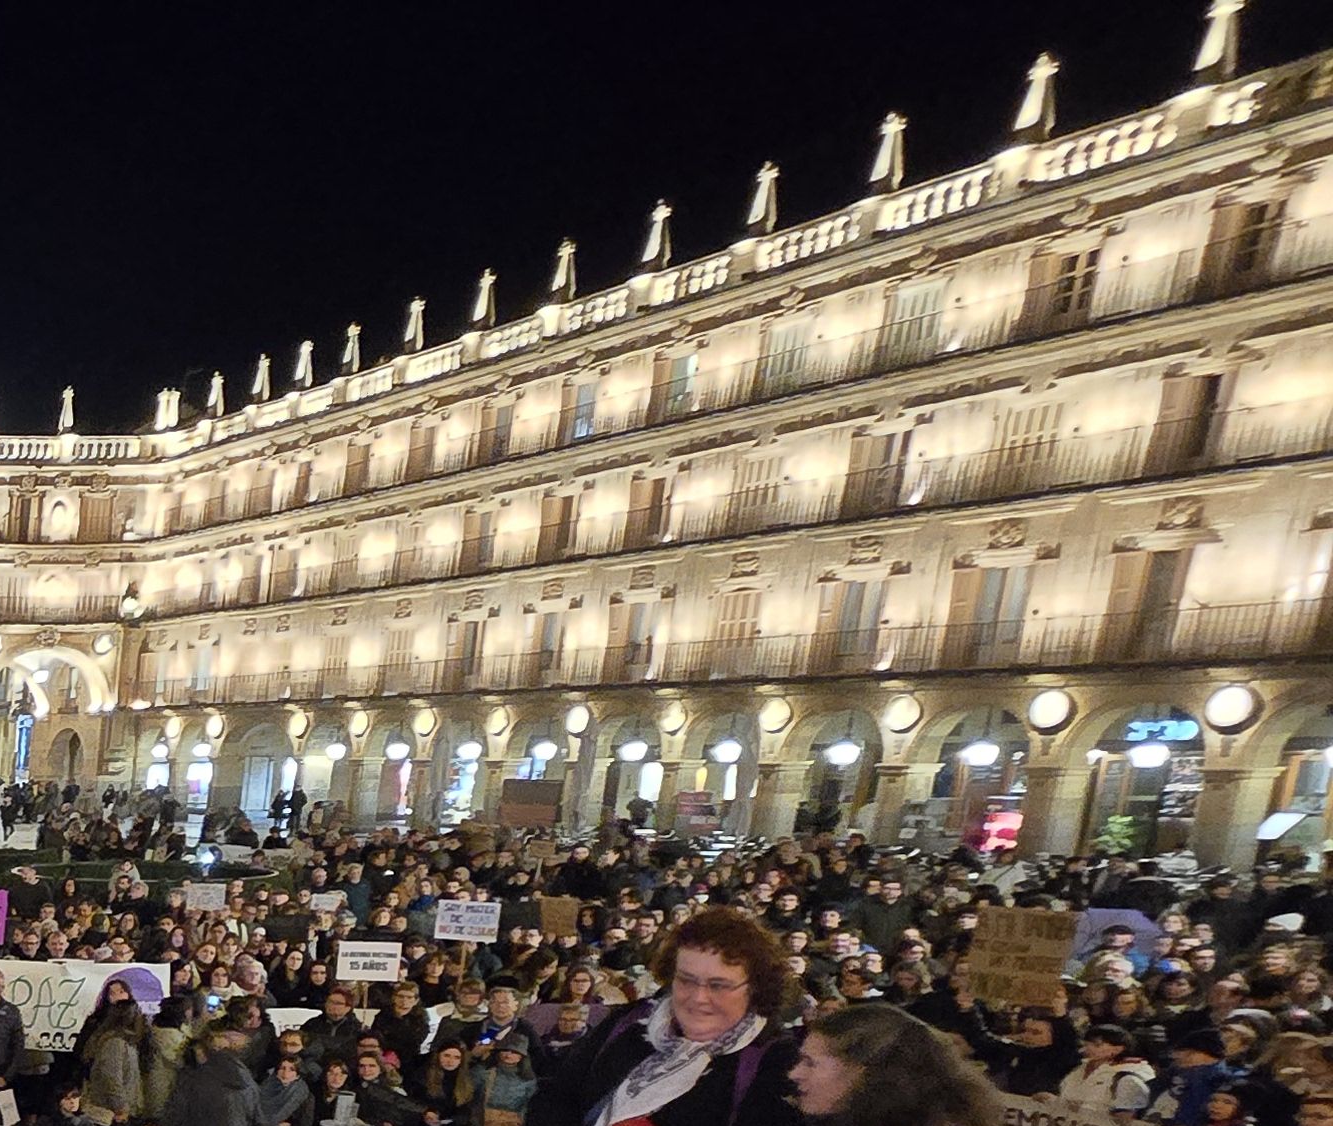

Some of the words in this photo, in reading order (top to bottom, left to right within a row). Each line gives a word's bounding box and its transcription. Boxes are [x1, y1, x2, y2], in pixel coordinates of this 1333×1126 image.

[349, 961, 360, 971] 15
[361, 960, 389, 972] AÑOS
[8, 976, 87, 1032] PAZ
